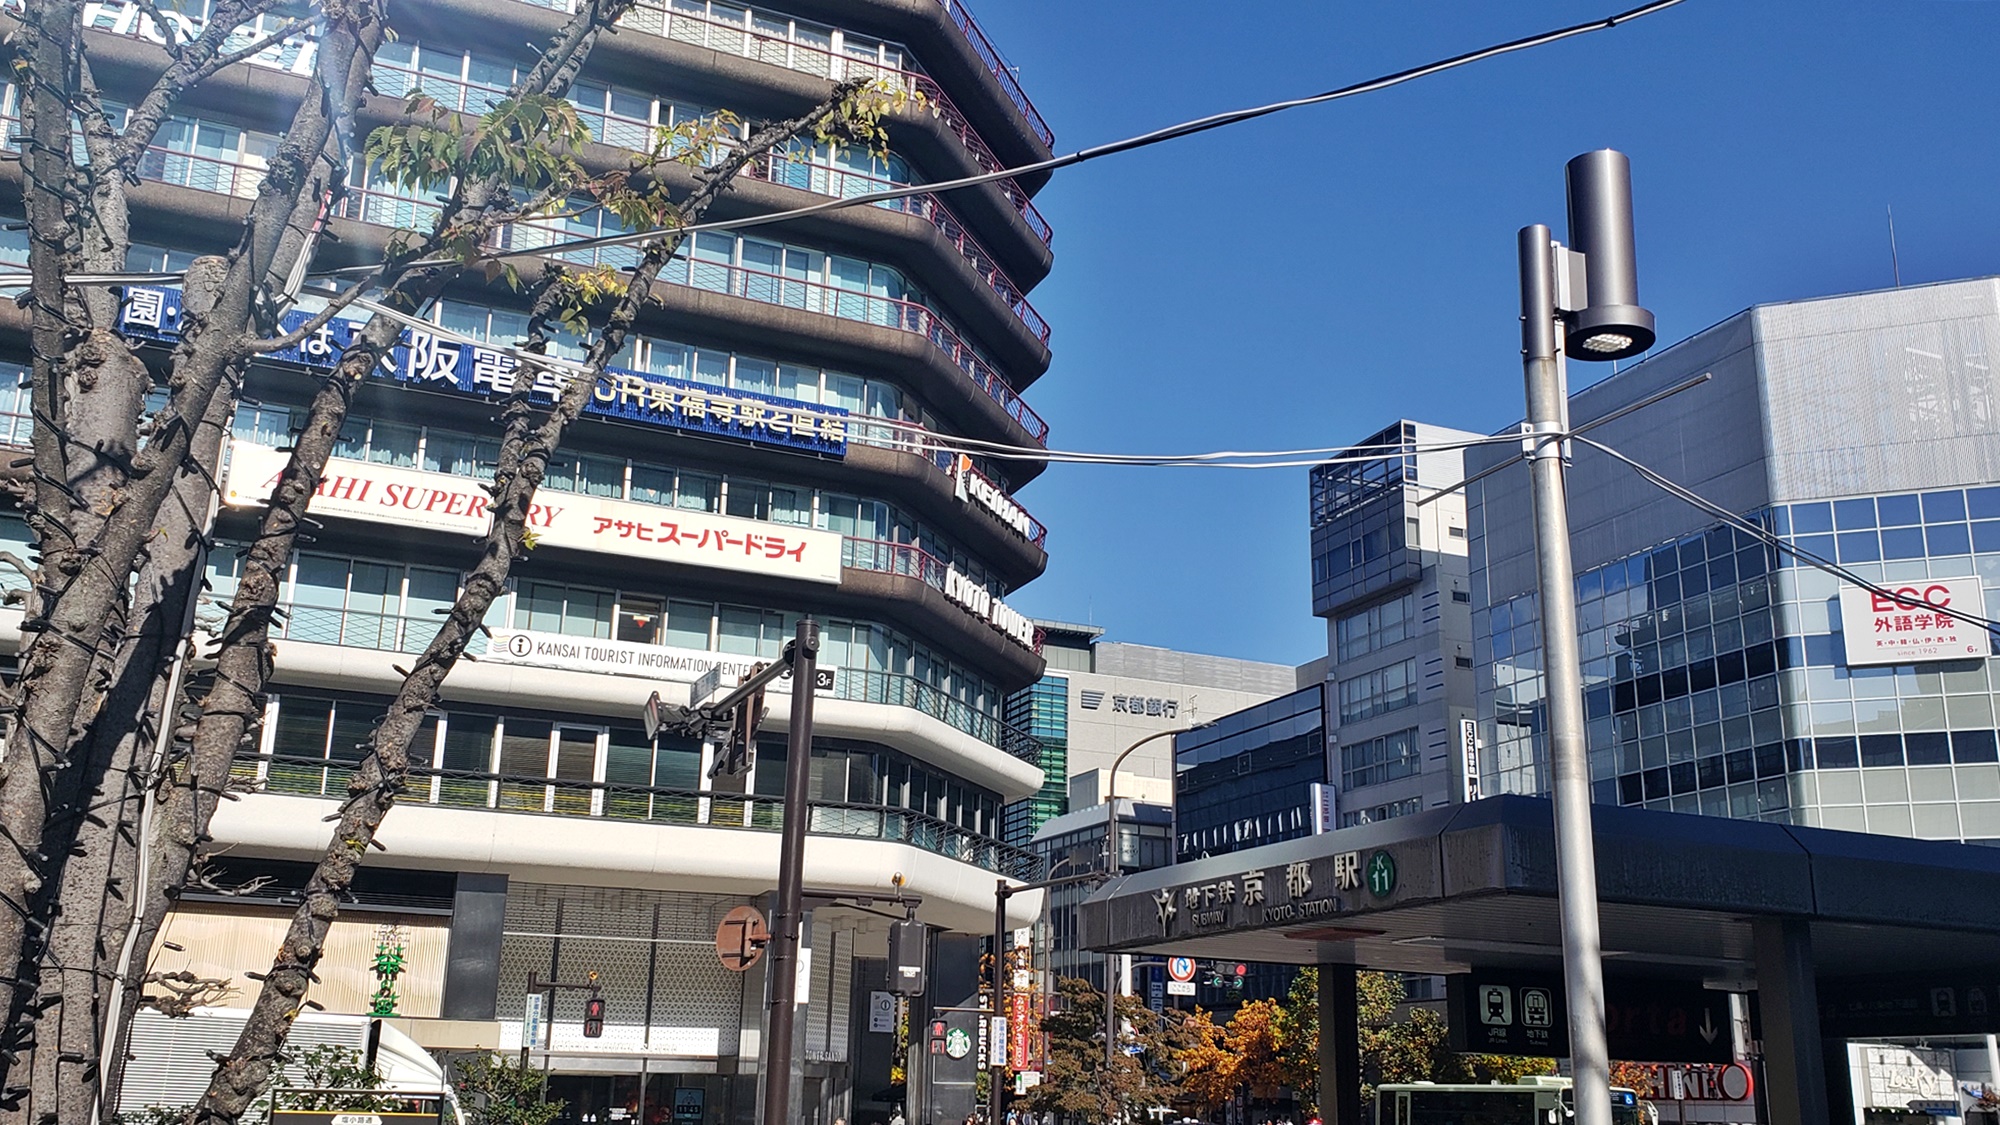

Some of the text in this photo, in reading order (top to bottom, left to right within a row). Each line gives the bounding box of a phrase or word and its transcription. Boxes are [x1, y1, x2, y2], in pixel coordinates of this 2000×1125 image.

[261, 471, 375, 502] AAHI
[380, 483, 488, 519] SUPER
[969, 473, 1031, 539] KEIHAN
[945, 566, 1035, 647] KYOTO TOWER
[1870, 585, 1951, 613] ECC
[1874, 613, 1955, 633] 外語学院
[537, 642, 832, 687] KANSAI TOURIST INFORMATION ENTE 3F
[1918, 647, 1938, 655] 1962
[1112, 694, 1179, 719] 京都銀行
[1376, 855, 1385, 870] K
[1185, 851, 1361, 910] 地下鉄 京都駅
[1371, 870, 1390, 893] 11
[1192, 898, 1337, 927] SUBWAY KYOTO STATION
